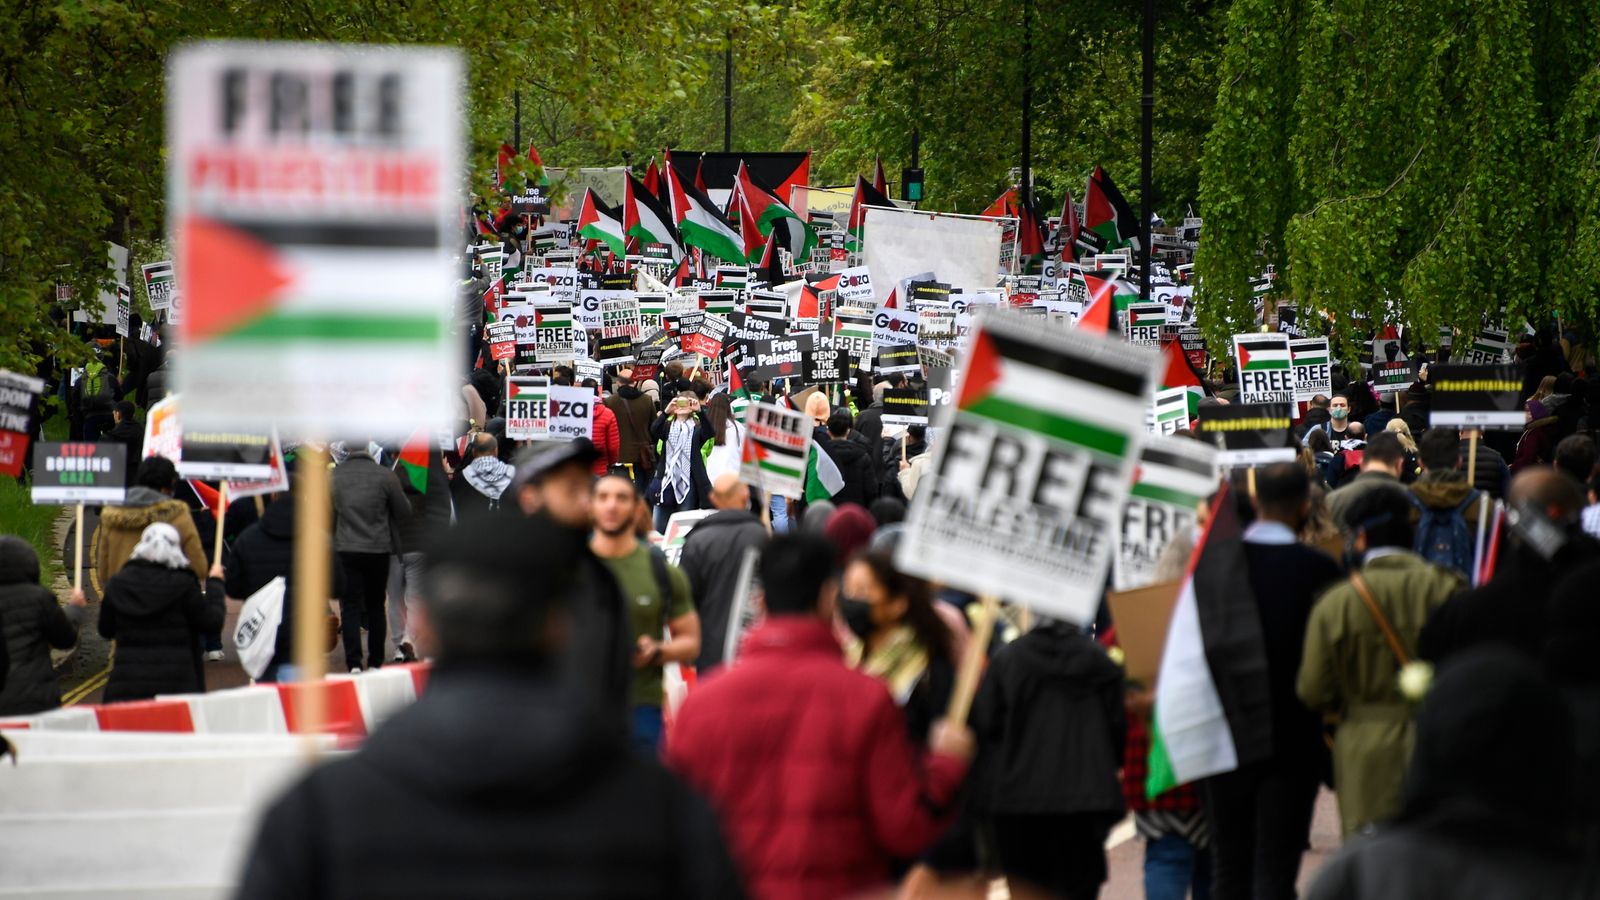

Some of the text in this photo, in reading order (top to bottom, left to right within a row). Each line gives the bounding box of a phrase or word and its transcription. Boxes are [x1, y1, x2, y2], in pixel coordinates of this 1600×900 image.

[220, 67, 406, 138] FREE
[523, 187, 540, 196] ree
[148, 281, 176, 295] FREE
[692, 280, 712, 290] Free
[1068, 284, 1086, 298] FREE
[602, 302, 612, 312] FREE
[613, 300, 636, 311] PALESTINE
[602, 309, 638, 320] EXIST!
[680, 316, 704, 325] FREEDOM
[604, 317, 639, 328] RESIST!
[704, 318, 728, 332] FREEDOM
[744, 315, 770, 330] Free
[1280, 320, 1307, 338] Pales
[536, 328, 572, 342] FREE
[574, 330, 586, 342] za
[604, 325, 640, 338] RETURN!
[680, 326, 700, 334] PALEST
[698, 326, 724, 342] PALESTINE
[834, 336, 872, 352] FREE
[885, 334, 896, 342] the
[536, 342, 573, 350] PALESTINE
[771, 340, 797, 352] Free
[758, 351, 802, 366] Palestin
[811, 350, 838, 360] #END
[1465, 350, 1502, 364] FREE
[816, 360, 834, 370] THE
[812, 368, 840, 380] SIEGE
[1380, 368, 1410, 376] BOMBING
[1242, 370, 1294, 392] FREE
[1244, 391, 1294, 403] PALESTINE
[509, 401, 546, 418] FREE
[559, 401, 588, 418] za
[509, 420, 547, 428] PALESTINE
[558, 424, 587, 436] siege
[60, 442, 96, 457] STOP
[46, 456, 111, 472] BOMBING
[59, 471, 94, 485] GAZA
[937, 421, 1116, 523] FREE
[929, 489, 1100, 558] PALESTINE
